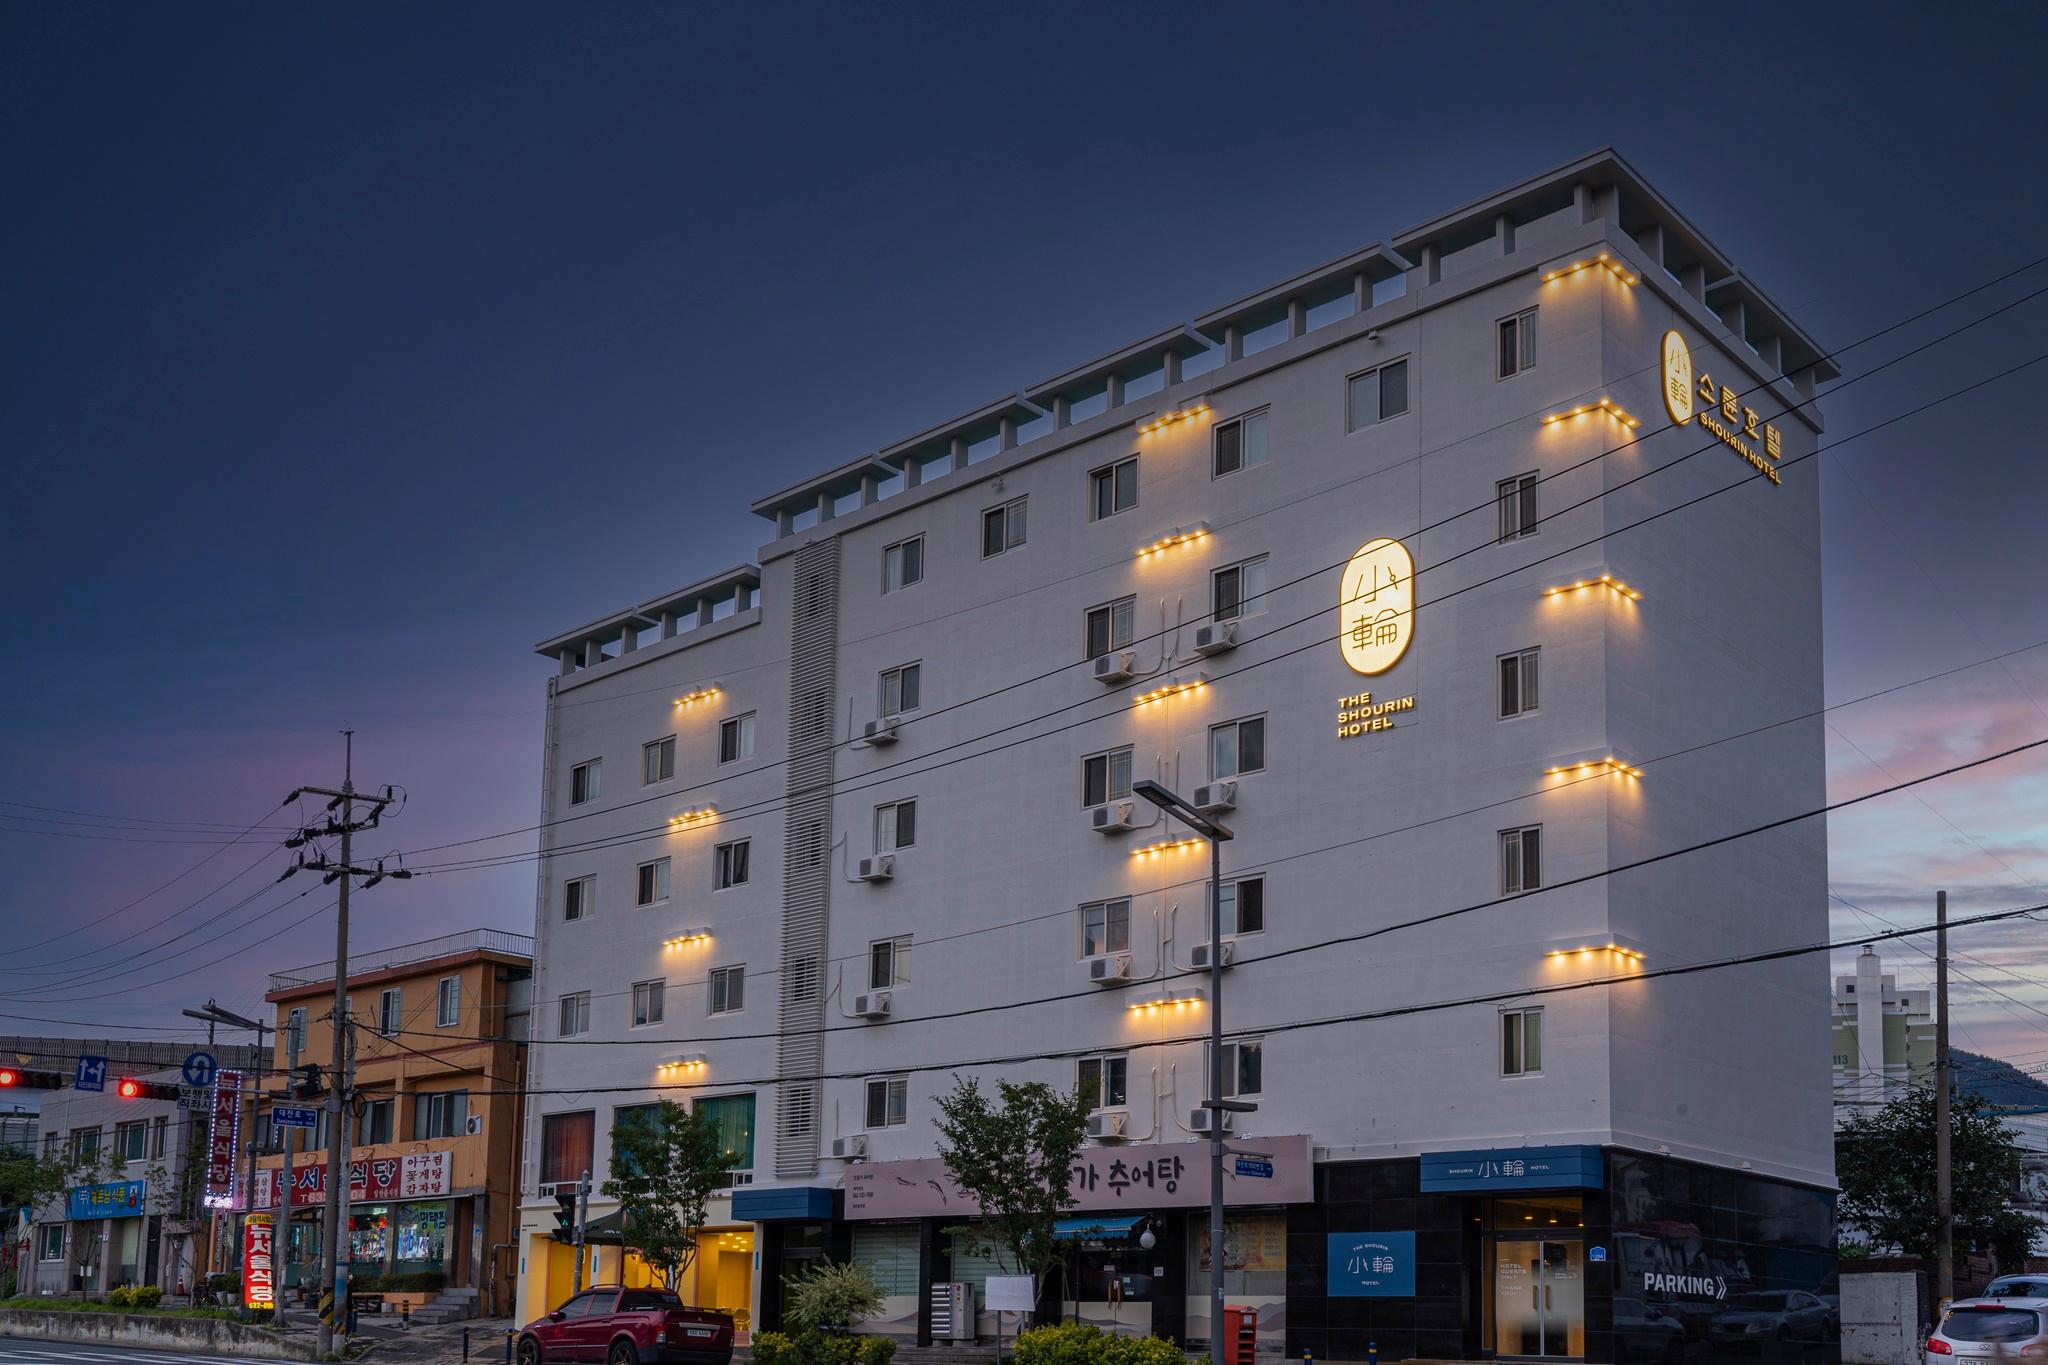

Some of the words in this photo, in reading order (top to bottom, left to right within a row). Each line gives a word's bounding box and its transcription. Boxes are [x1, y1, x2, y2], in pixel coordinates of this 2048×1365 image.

[1700, 412, 1748, 458] SHOURIN
[1748, 451, 1783, 485] HOTEL
[1337, 692, 1371, 708] THE
[1337, 696, 1414, 724] SHOURIN
[1337, 717, 1393, 739] HOTEL
[212, 1073, 236, 1183] 뉴서울식당
[407, 1154, 443, 1167] 아구찜
[406, 1168, 443, 1182] 꽃게탕
[1107, 1155, 1185, 1197] 추어탕
[406, 1181, 443, 1195] 감자탕
[248, 1224, 273, 1302] 뉴서울식당
[1643, 1272, 1715, 1297] PARKING
